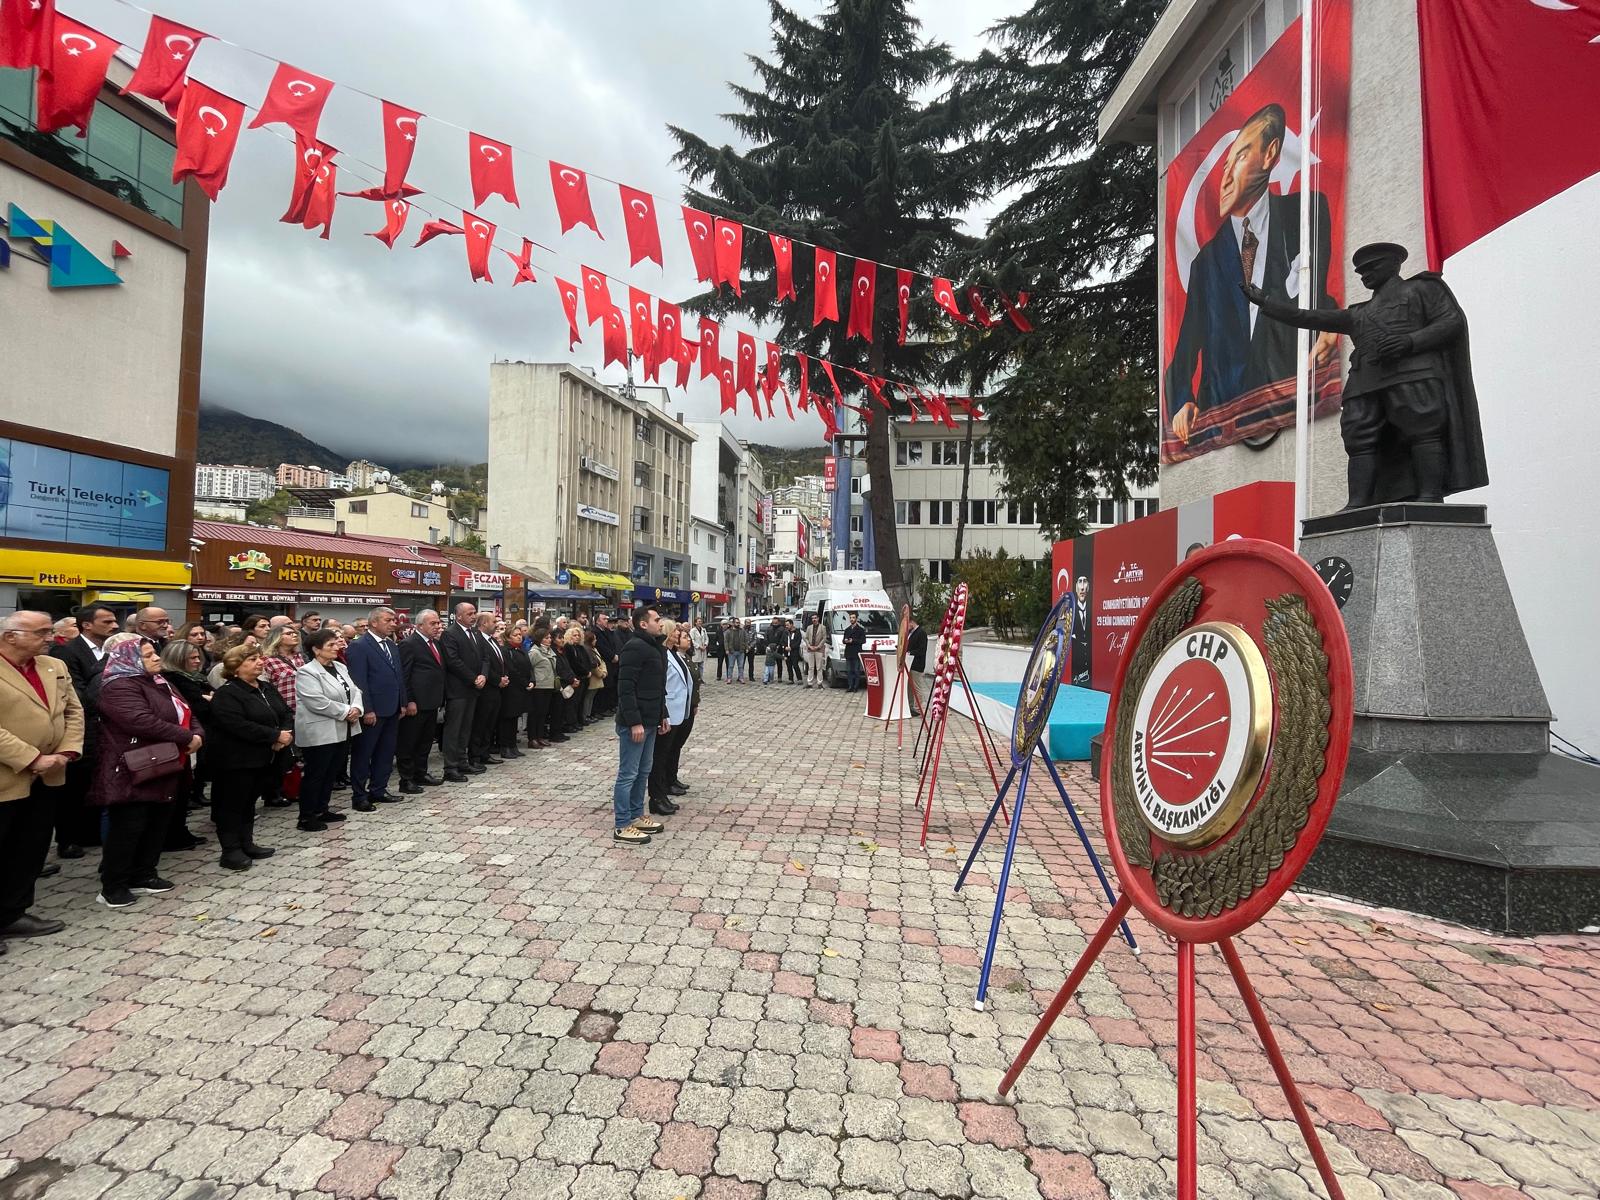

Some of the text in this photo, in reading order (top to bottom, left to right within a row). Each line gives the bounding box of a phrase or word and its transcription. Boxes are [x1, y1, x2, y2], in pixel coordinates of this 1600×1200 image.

[28, 480, 137, 507] Türk Telekom
[337, 558, 373, 572] SEBZE
[39, 572, 82, 585] PttBank
[245, 568, 255, 580] 2
[278, 568, 323, 583] MEYVE
[326, 571, 377, 586] DÜNYASI
[197, 592, 222, 600] ARTVİN
[1096, 616, 1102, 626] 29
[1102, 615, 1112, 626] EKİM
[1186, 634, 1229, 663] CHP
[1134, 730, 1226, 830] ARTVİN İL BAŞKANLIĞI
